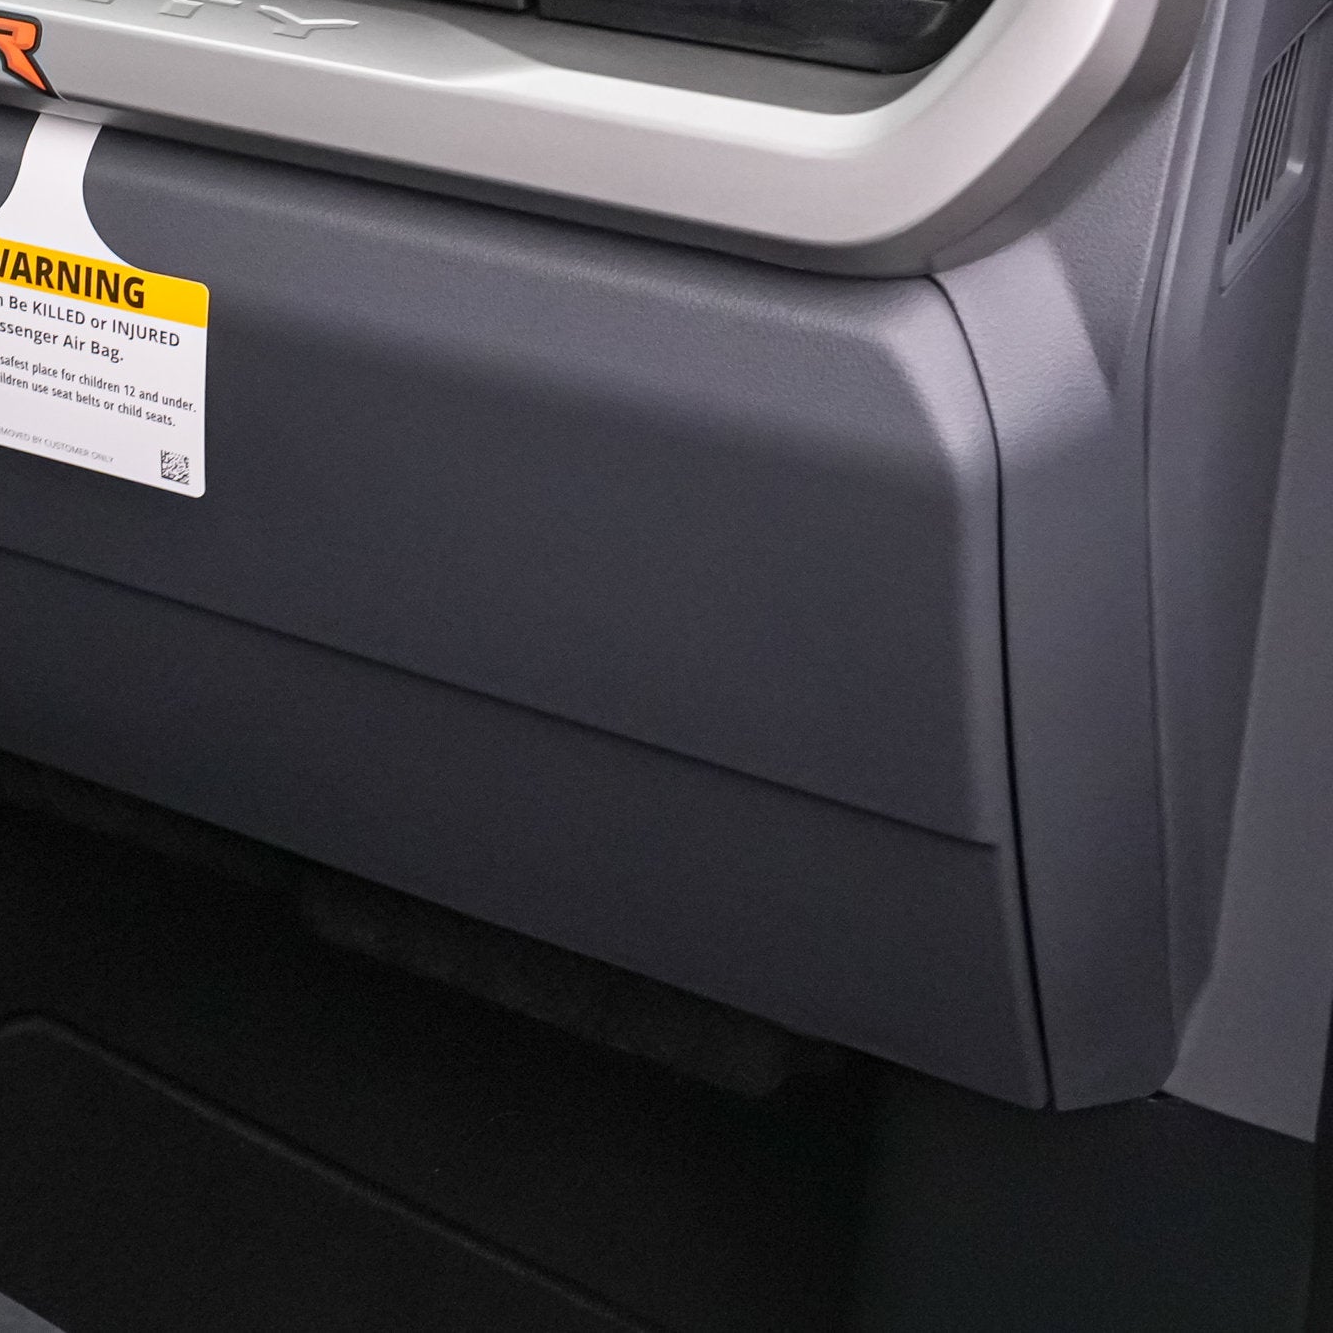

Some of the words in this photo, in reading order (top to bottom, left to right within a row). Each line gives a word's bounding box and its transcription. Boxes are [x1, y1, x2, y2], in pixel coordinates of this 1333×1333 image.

[9, 295, 28, 312] Be
[32, 300, 86, 325] KILLED
[90, 317, 108, 331] or
[112, 319, 180, 347] INJURED
[62, 334, 86, 351] Air
[91, 340, 124, 364] Bag.
[0, 355, 29, 371] safest
[32, 362, 58, 379] place
[61, 368, 76, 382] for
[78, 373, 120, 394] children
[124, 384, 136, 398] 12
[139, 390, 159, 403] and
[162, 396, 197, 413] under.
[31, 382, 49, 395] use
[51, 387, 73, 401] seat
[76, 390, 101, 408] belts
[103, 400, 115, 411] or
[117, 402, 142, 418] child
[145, 411, 176, 427] seats.
[44, 438, 90, 457] CUSTOMER
